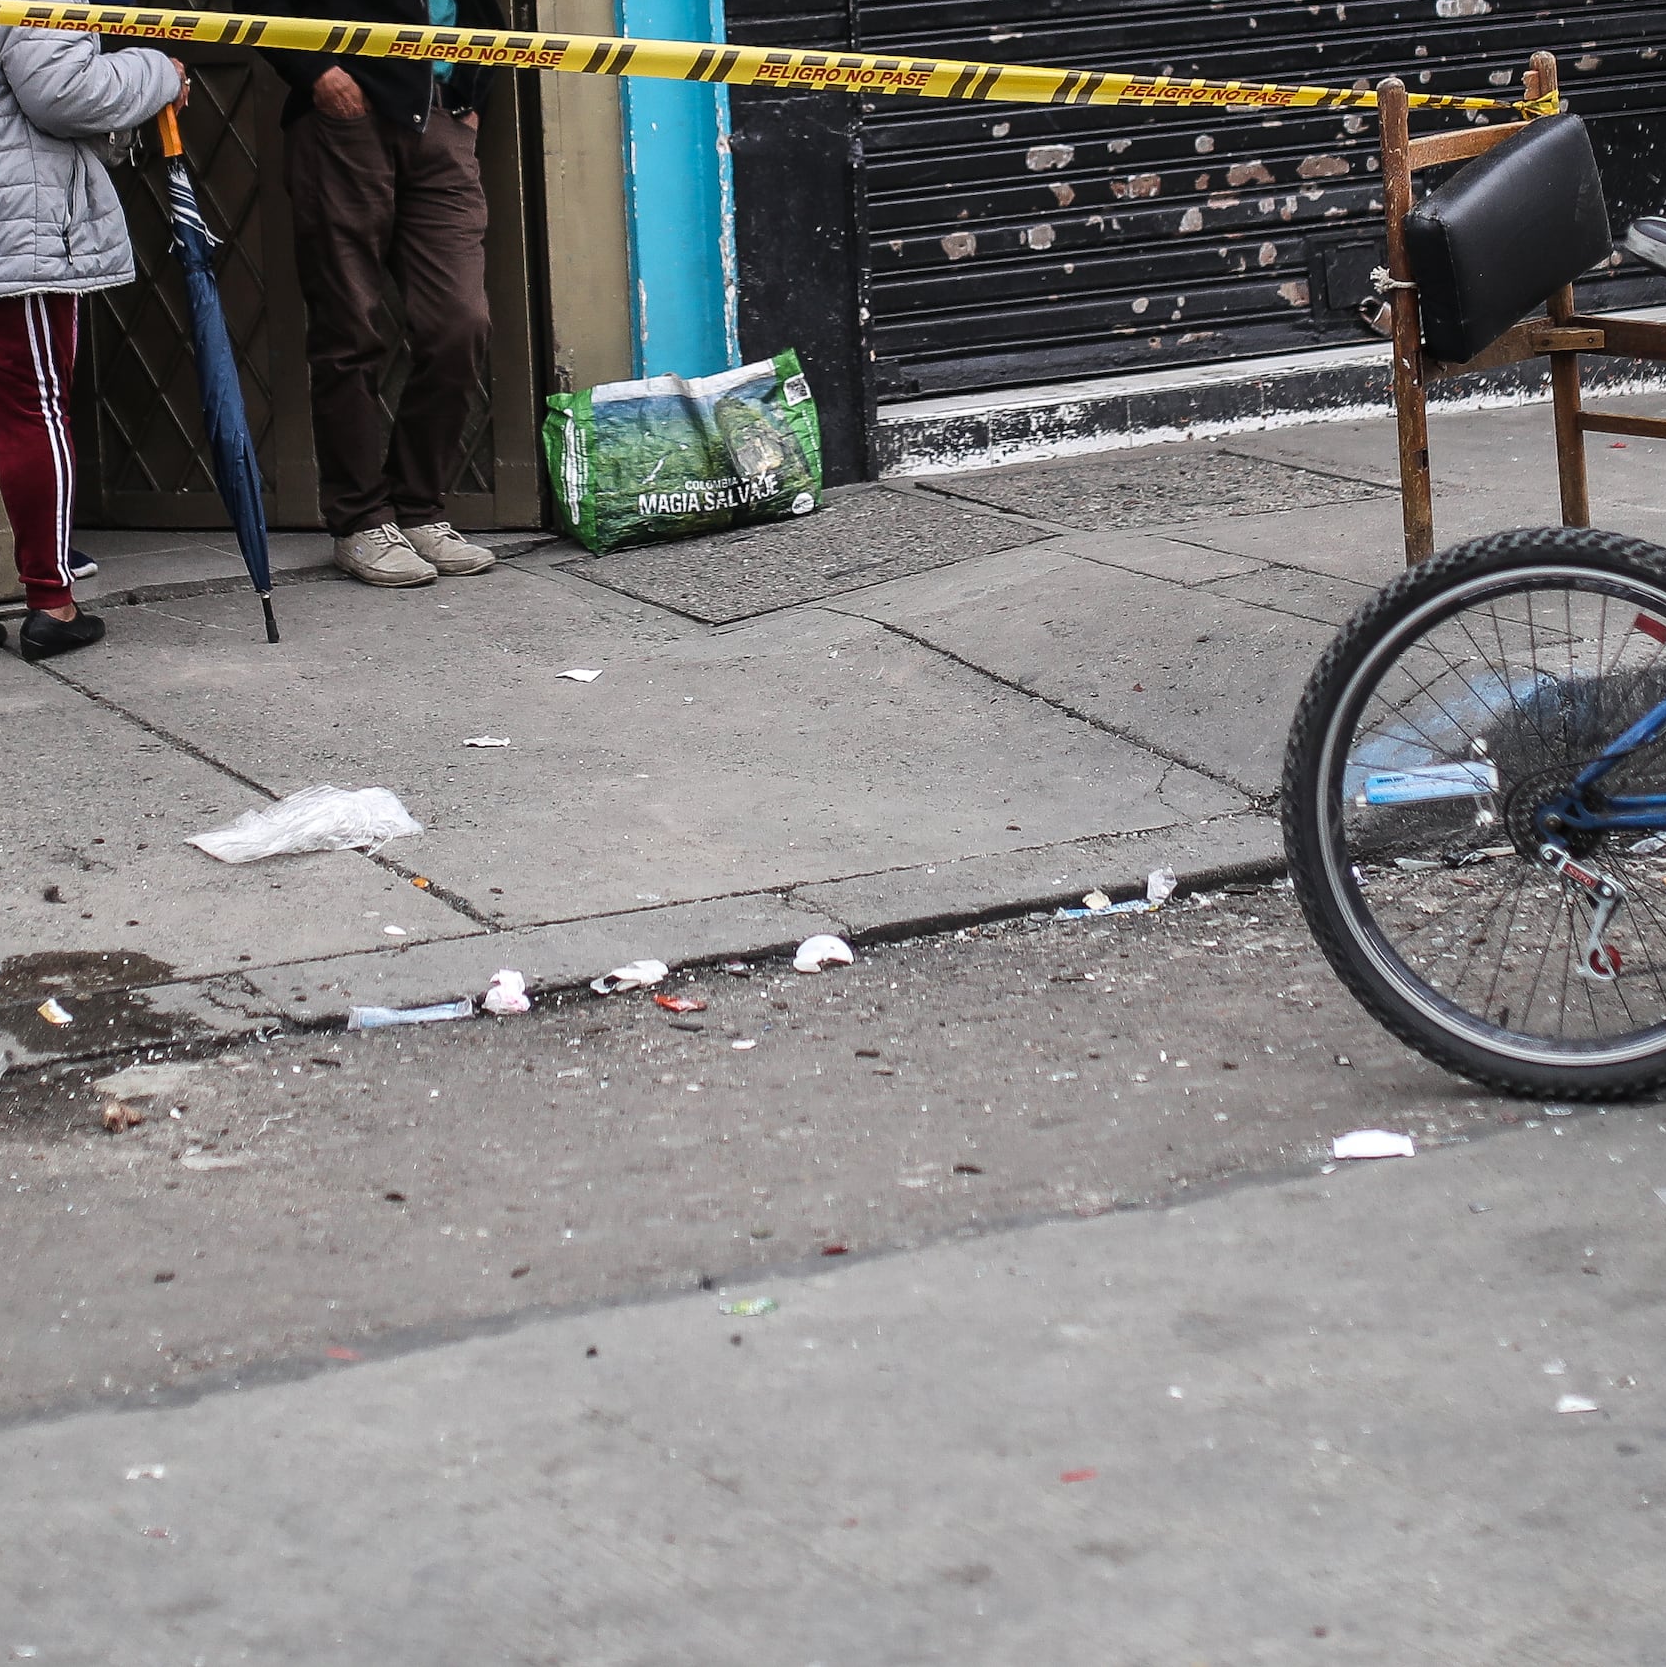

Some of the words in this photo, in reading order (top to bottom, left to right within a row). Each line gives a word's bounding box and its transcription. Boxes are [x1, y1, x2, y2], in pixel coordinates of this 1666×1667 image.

[388, 41, 473, 60] PELIGRO
[477, 47, 508, 61] NO
[512, 50, 565, 65] PASE
[755, 63, 841, 82] PELIGRO
[844, 69, 876, 84] NO
[878, 71, 932, 87] PASE
[1119, 84, 1209, 100] PELIGRO
[1212, 89, 1243, 102] NO
[1244, 90, 1296, 104] PASE
[637, 492, 702, 516] MAGIA
[703, 474, 780, 513] SALVAJE
